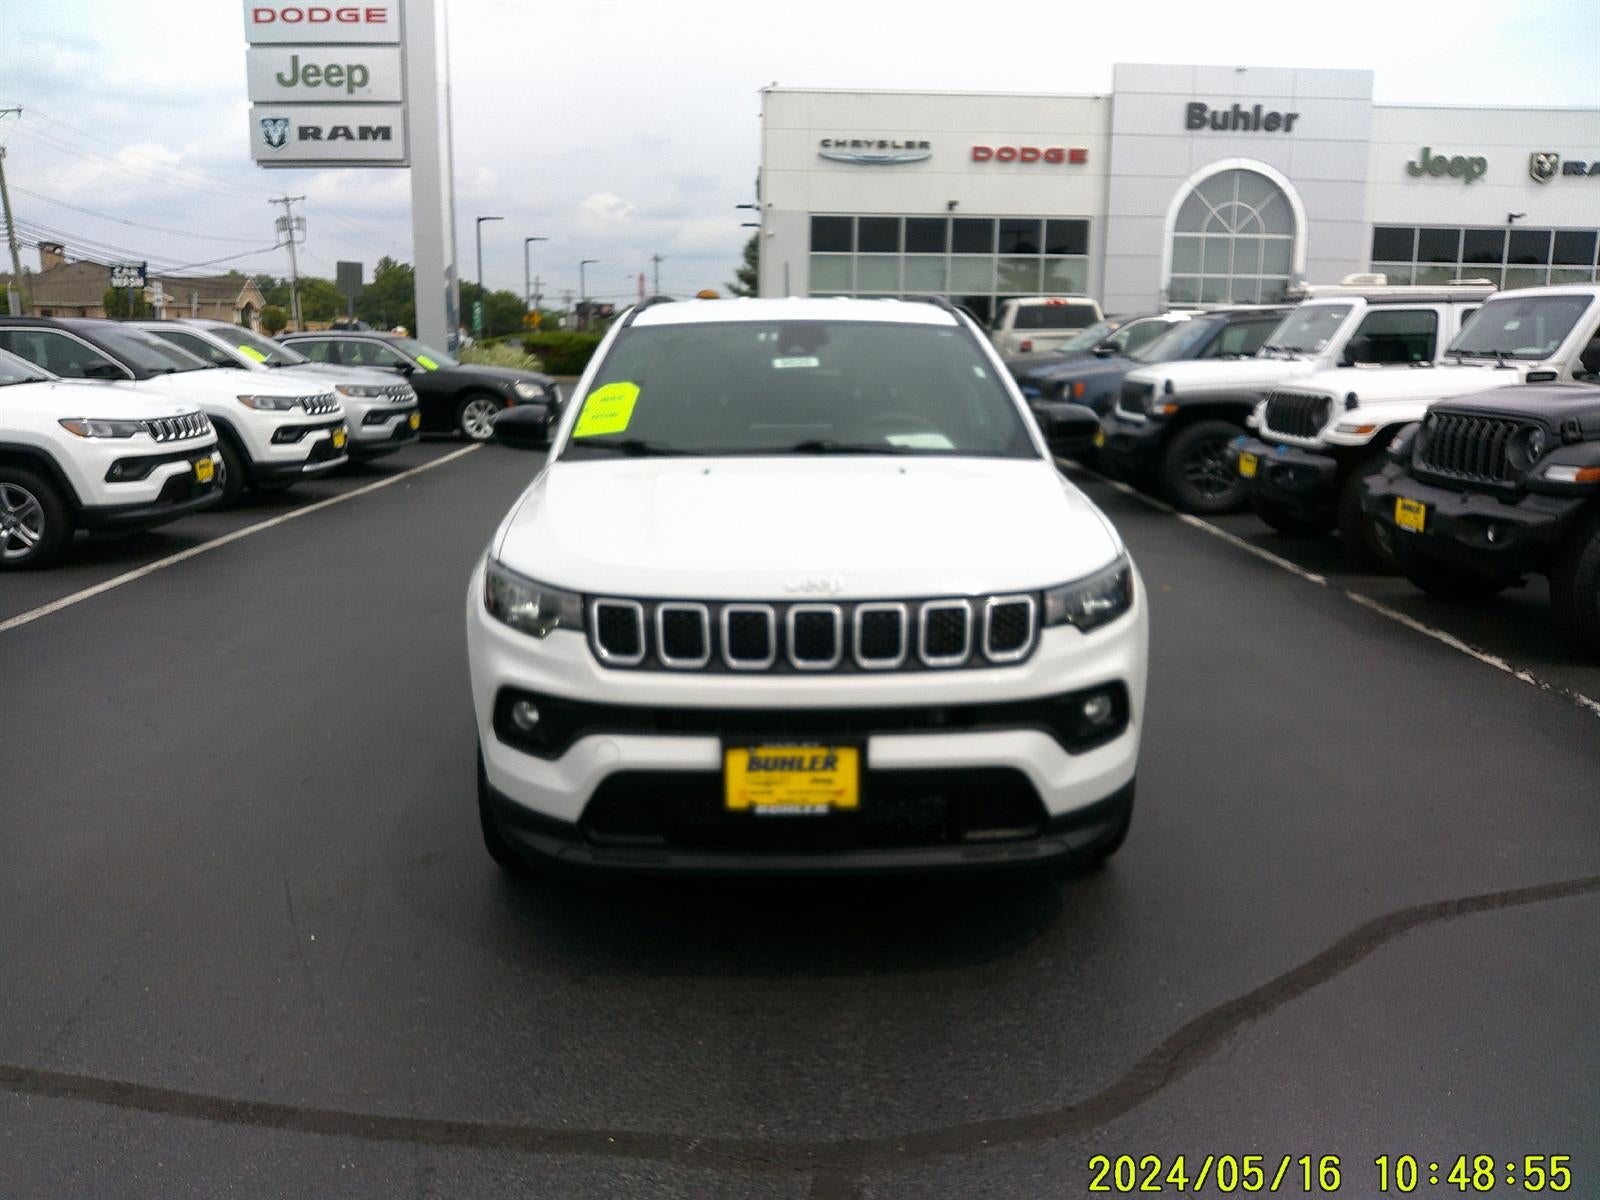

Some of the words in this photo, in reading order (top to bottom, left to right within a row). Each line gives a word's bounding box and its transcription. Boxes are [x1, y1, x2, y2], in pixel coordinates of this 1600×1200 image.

[253, 8, 387, 23] DODGE
[277, 55, 369, 94] Jeep
[1186, 102, 1300, 132] Buhler
[298, 126, 391, 140] RAM
[820, 138, 931, 150] CHRYSLER
[971, 145, 1089, 165] DODGE
[1406, 146, 1488, 185] Jeep
[747, 756, 838, 772] BUHLER
